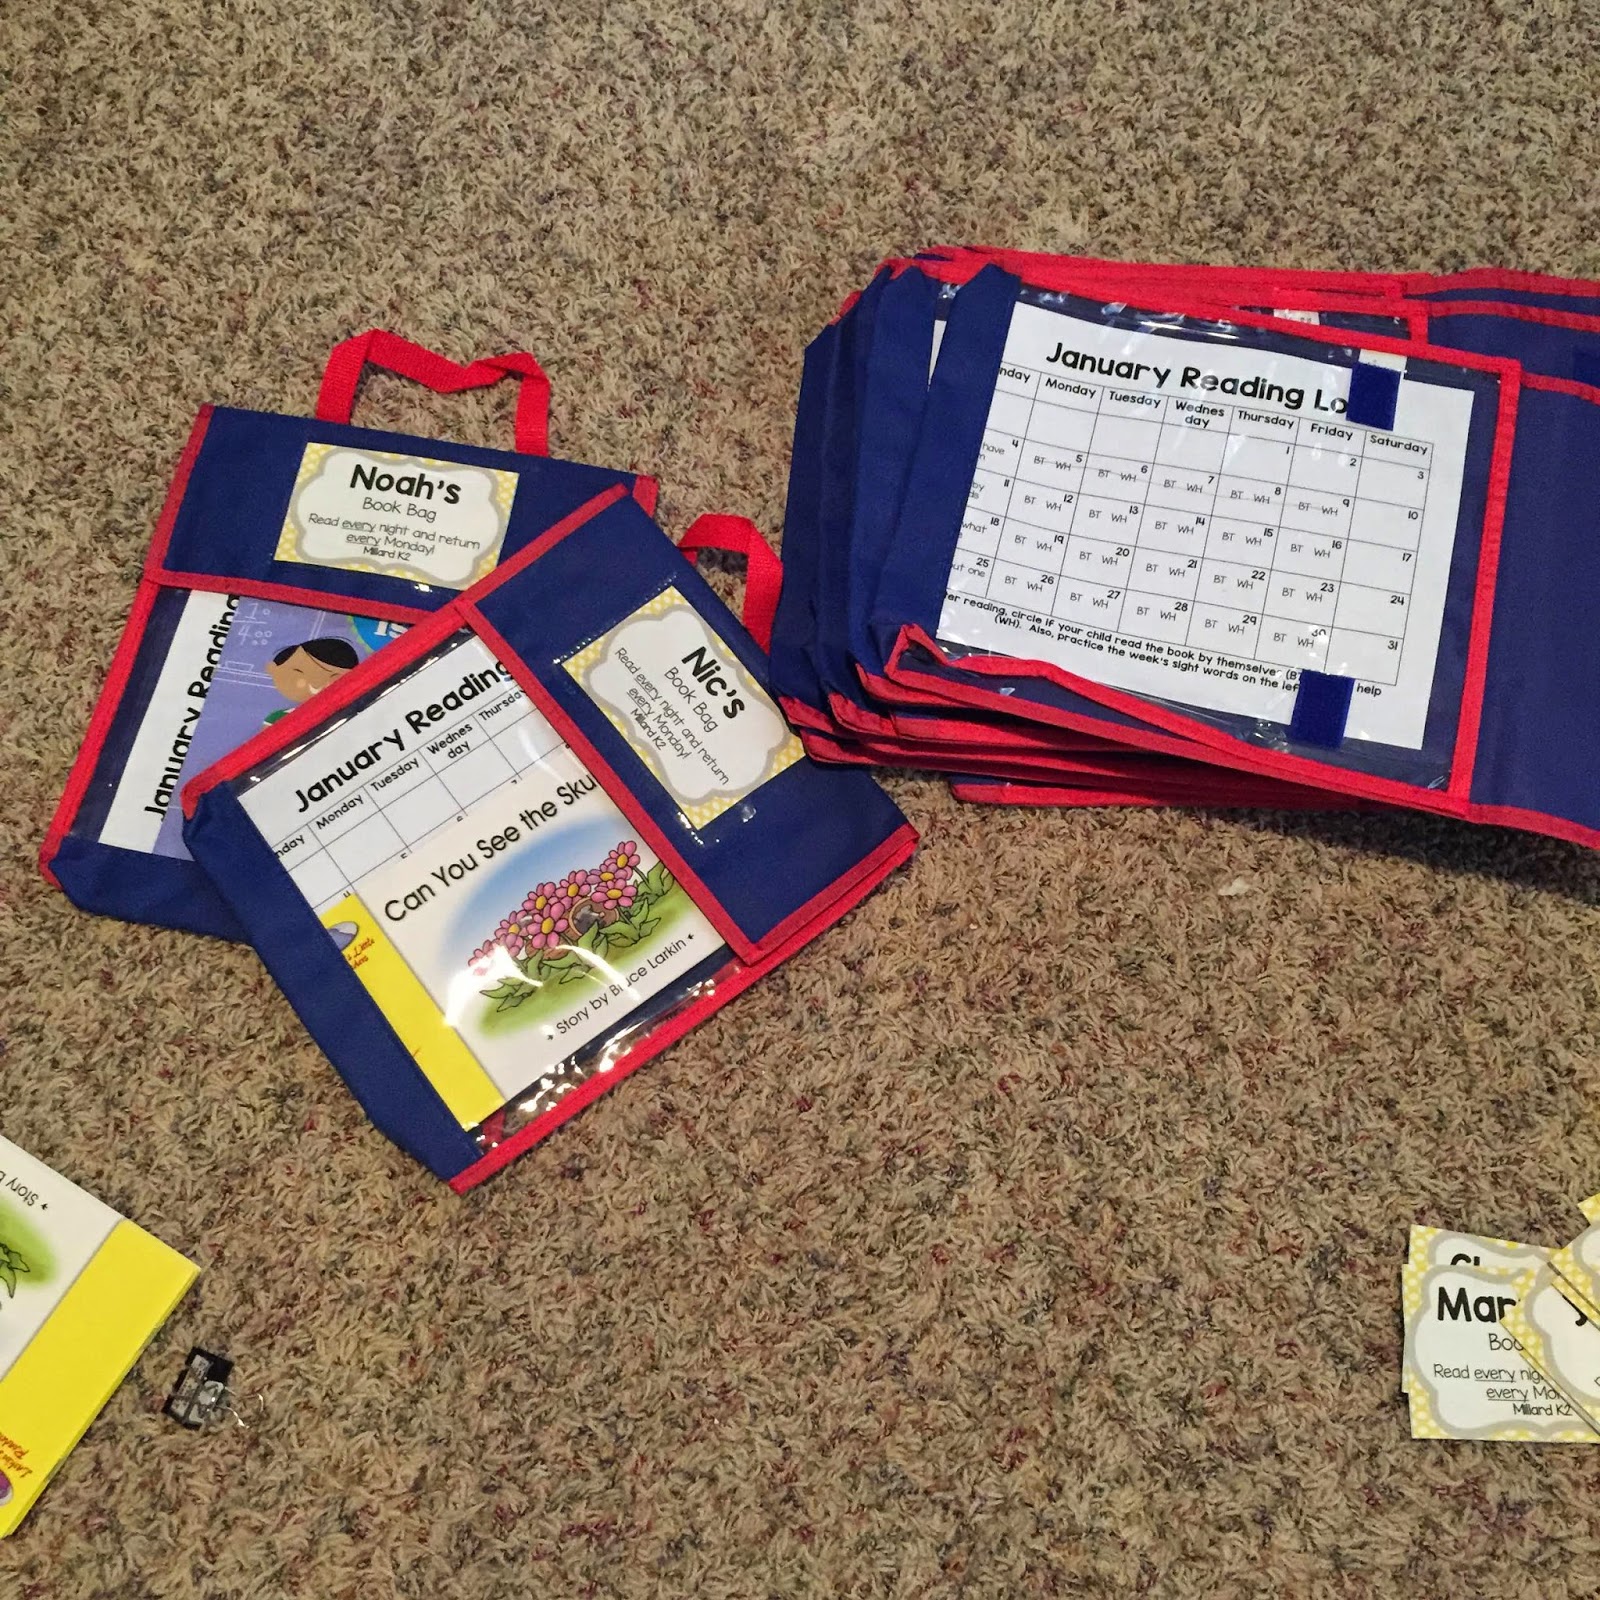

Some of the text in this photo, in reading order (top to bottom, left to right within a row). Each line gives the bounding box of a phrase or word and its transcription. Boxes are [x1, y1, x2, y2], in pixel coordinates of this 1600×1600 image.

[1047, 343, 1171, 388] January
[1181, 367, 1305, 410] Reading
[1045, 378, 1096, 398] Monday
[1109, 391, 1161, 408] Tuesday
[1176, 401, 1225, 417] Wednes
[1238, 410, 1294, 429] Thursday
[1311, 424, 1353, 441] Friday
[1371, 435, 1428, 455] Saturday
[1185, 416, 1210, 428] day
[1012, 440, 1019, 448] 4
[1034, 457, 1071, 471] BT WH
[1076, 454, 1082, 463] 5
[1350, 458, 1356, 467] 2
[1141, 465, 1148, 473] 6
[1417, 471, 1424, 479] 3
[350, 464, 462, 505] Noah's
[1164, 480, 1202, 493] BT WH
[1208, 476, 1214, 485] 7
[1231, 491, 1270, 503] BT WH
[1275, 487, 1281, 495] 8
[1024, 496, 1061, 511] BT WH
[1064, 494, 1073, 503] 12
[362, 497, 437, 523] Book Bag
[1129, 506, 1138, 515] 13
[1298, 502, 1338, 515] BT WH
[991, 517, 999, 526] 18
[1089, 510, 1127, 523] BT WH
[1195, 518, 1205, 526] 14
[1408, 511, 1418, 520] 10
[308, 513, 480, 550] Read every night and return
[962, 522, 987, 533] what
[1155, 521, 1194, 534] BT WH
[1264, 528, 1273, 537] 15
[346, 533, 435, 556] every Monday!
[1015, 535, 1052, 551] BT WH
[1054, 535, 1063, 544] 19
[1222, 532, 1262, 546] BT WH
[1332, 540, 1342, 549] 16
[397, 551, 411, 561] K2
[1116, 548, 1129, 557] 20
[1291, 544, 1331, 558] BT WH
[1402, 553, 1411, 562] 17
[976, 558, 989, 567] 25
[1080, 552, 1118, 566] BT WH
[1188, 560, 1197, 568] 21
[1146, 563, 1185, 577] BT WH
[1252, 571, 1265, 580] 22
[1005, 576, 1043, 592] BT WH
[1041, 575, 1054, 584] 26
[1214, 575, 1253, 589] BT WH
[1320, 583, 1334, 592] 23
[1070, 593, 1108, 609] BT WH
[1107, 590, 1121, 600] 27
[1282, 588, 1322, 602] BT WH
[1390, 596, 1404, 605] 24
[1174, 602, 1188, 611] 28
[1137, 607, 1176, 621] BT WH
[1243, 615, 1257, 625] 29
[964, 599, 1007, 617] reading,
[1011, 610, 1042, 625] circle
[1045, 618, 1054, 627] if
[1059, 624, 1084, 637] your
[1087, 628, 1112, 642] child
[1115, 636, 1141, 648] read
[1146, 642, 1164, 654] the
[1167, 646, 1194, 661] book
[1200, 652, 1212, 665] by
[1205, 619, 1245, 634] BT WH
[1274, 633, 1314, 648] BT WH
[1388, 641, 1398, 650] 31
[995, 614, 1022, 629] (WH).
[1029, 625, 1054, 638] Also,
[1058, 633, 1104, 652] practice
[1108, 644, 1125, 656] the
[1129, 649, 1168, 667] week's
[1173, 659, 1199, 676] sight
[1203, 668, 1239, 683] words
[1243, 675, 1255, 683] on
[1261, 676, 1278, 689] the
[1357, 684, 1381, 697] help
[681, 646, 744, 720] Nic's
[664, 667, 718, 732] Book Bag
[615, 647, 730, 785] Read every night and return
[628, 687, 692, 760] every Monday!
[630, 708, 667, 751] Millard K2
[448, 740, 470, 759] day
[144, 707, 201, 822] January
[295, 729, 406, 813] January
[316, 793, 364, 830] Monday
[370, 757, 420, 792] Tuesday
[428, 723, 472, 755] Wednes
[385, 881, 435, 921] Can
[431, 850, 478, 891] You
[477, 824, 520, 859] See
[519, 802, 557, 830] the
[557, 1007, 589, 1034] Story
[589, 994, 608, 1010] by
[647, 938, 687, 969] Larkin
[5, 1177, 39, 1206] Story
[1434, 1364, 1516, 1381] Read every
[1486, 1388, 1529, 1400] every
[1513, 1403, 1573, 1416] Millard K2
